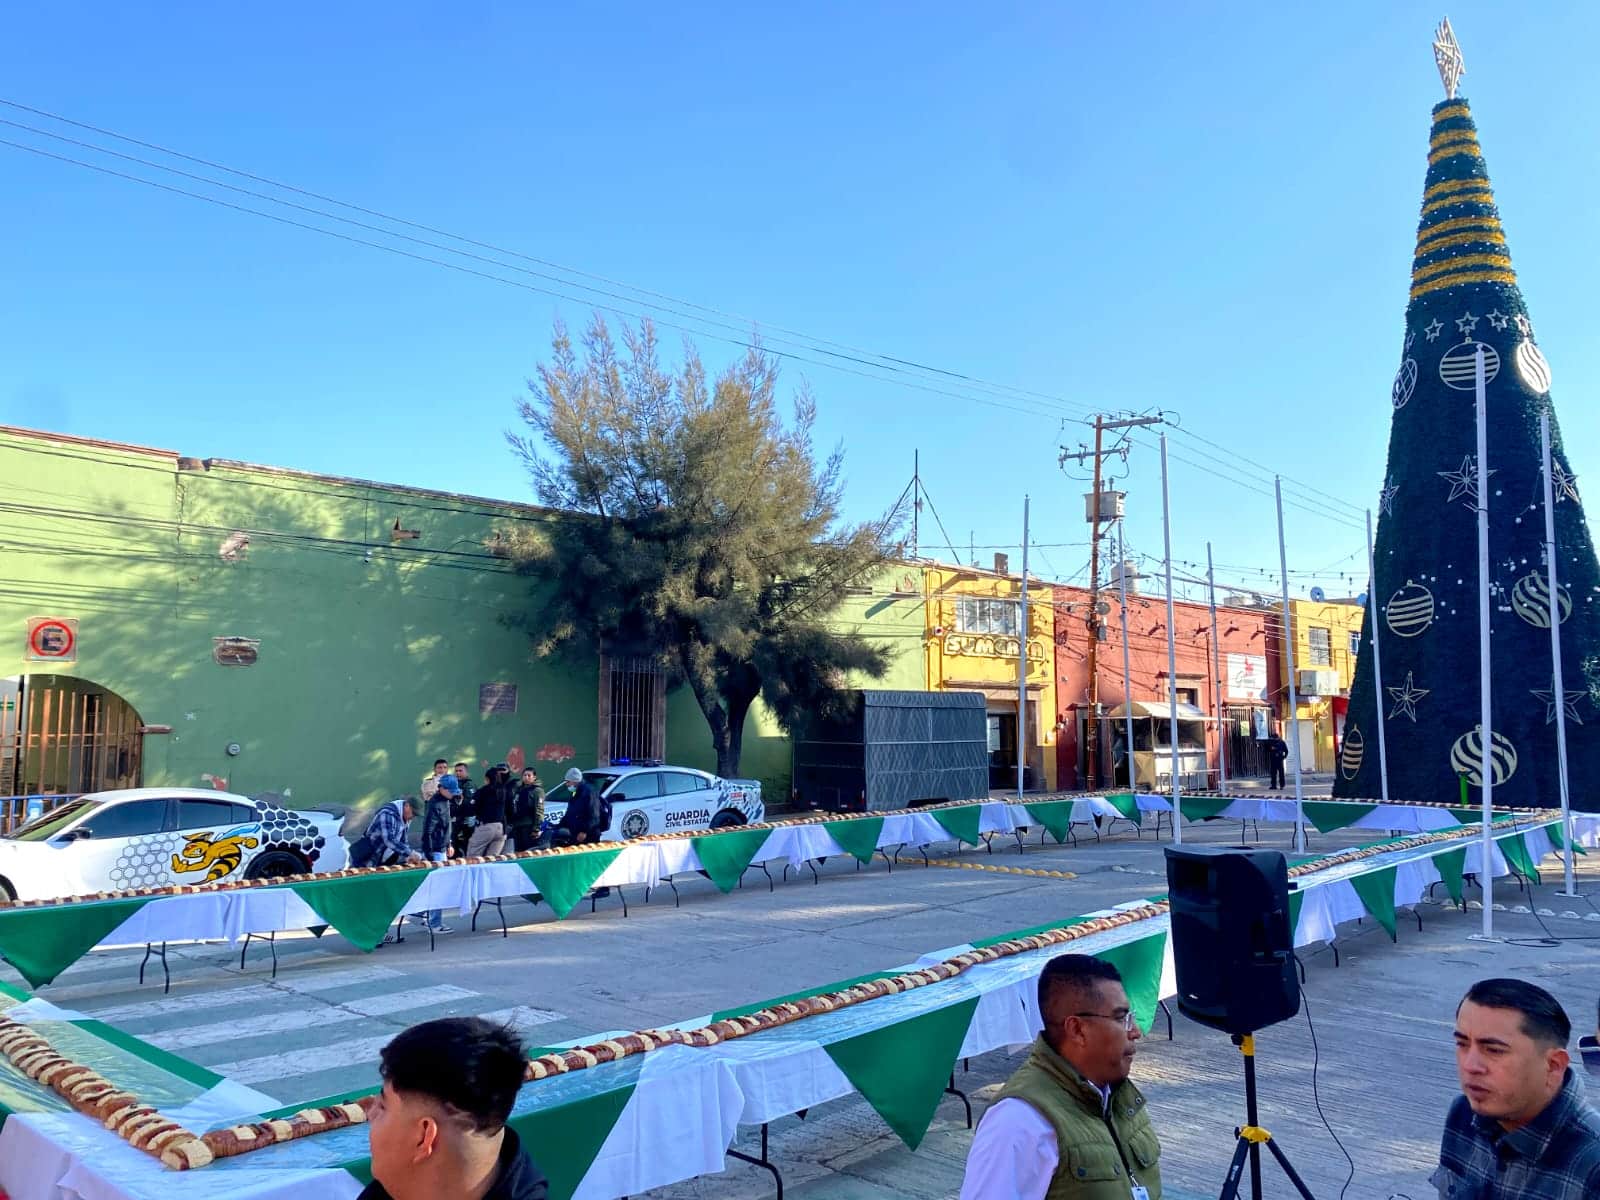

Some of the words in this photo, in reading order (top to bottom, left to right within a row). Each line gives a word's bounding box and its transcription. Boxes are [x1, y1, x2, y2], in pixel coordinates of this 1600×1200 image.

[42, 628, 64, 651] E
[665, 809, 710, 822] GUARDIA
[683, 818, 710, 826] ESTATAL
